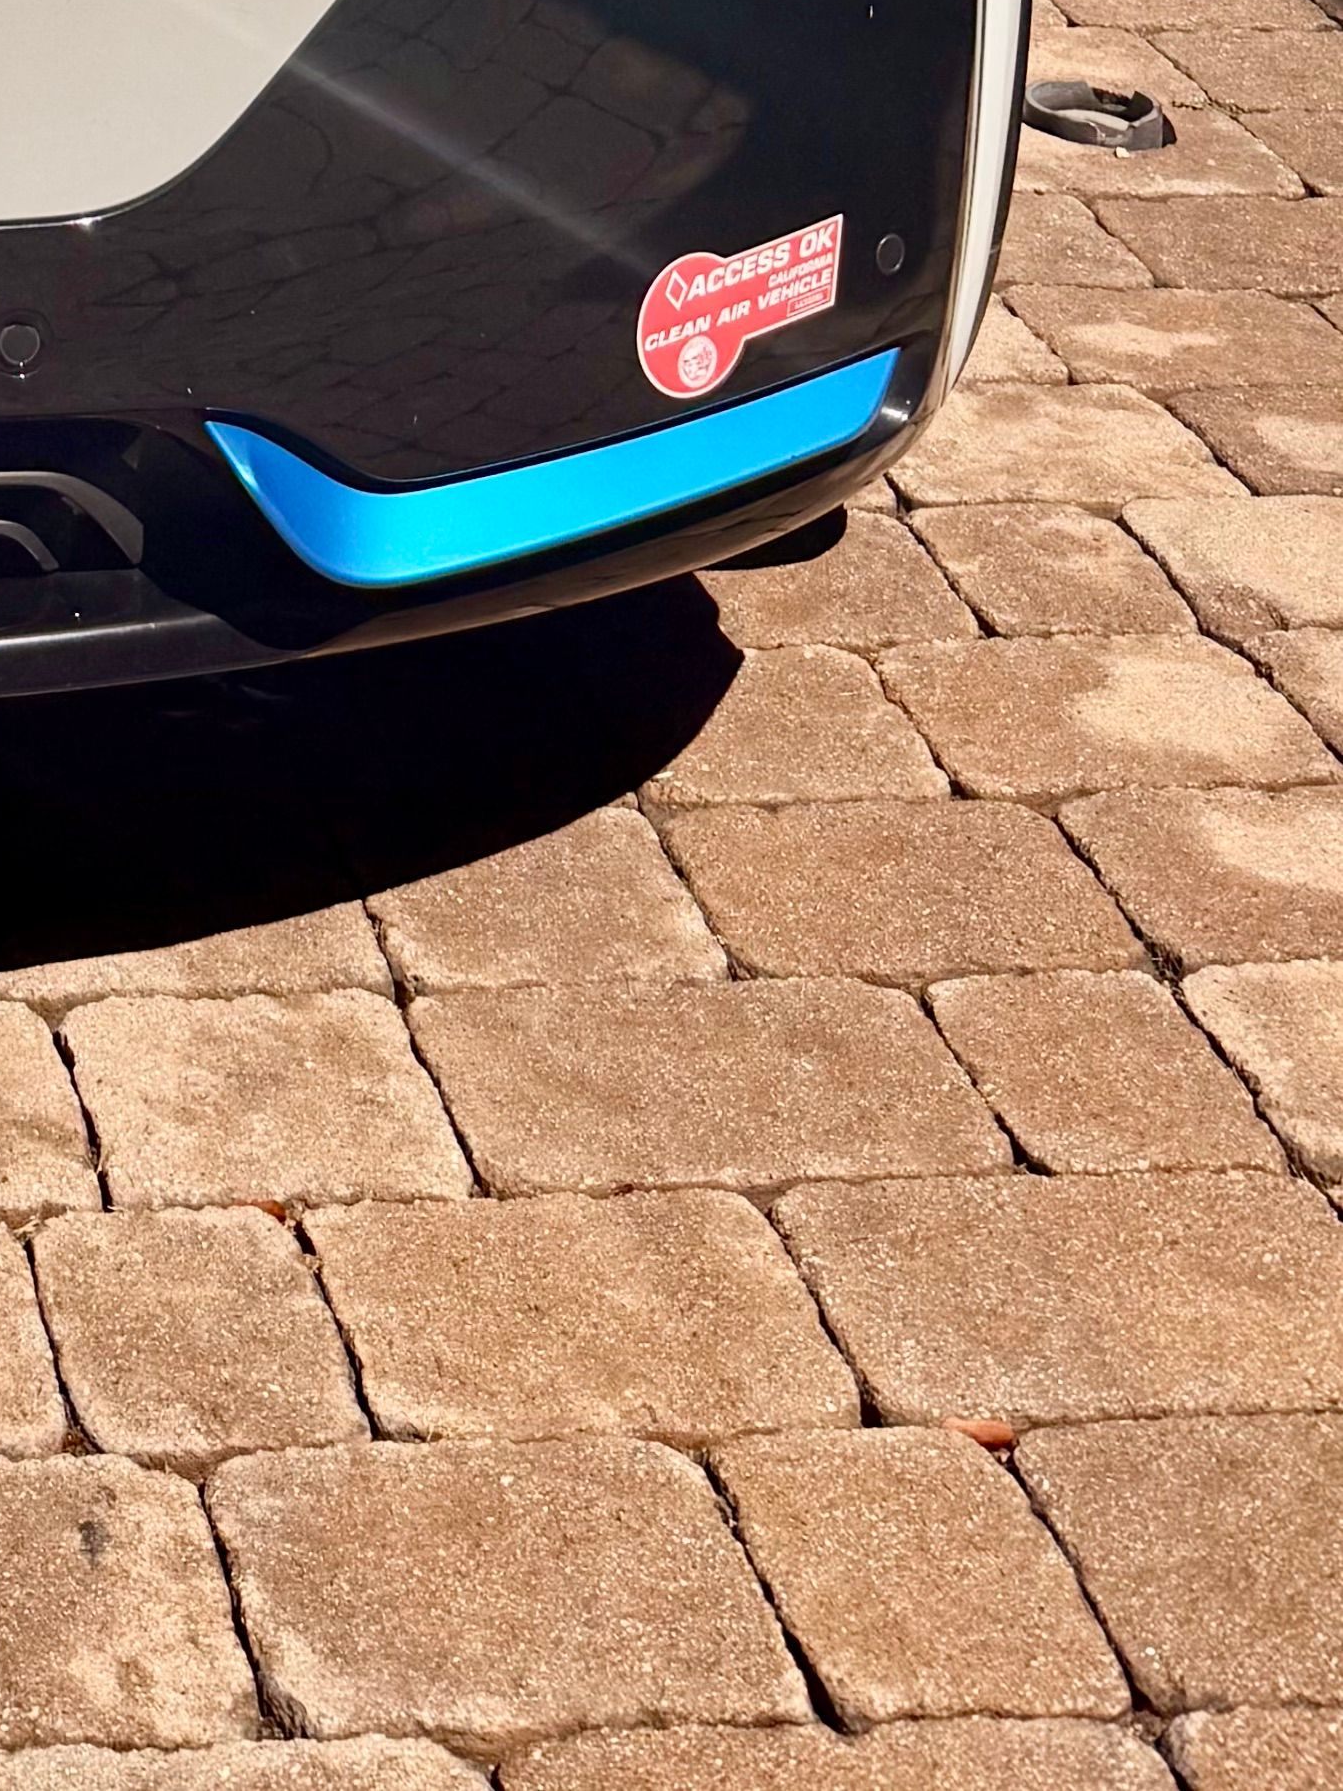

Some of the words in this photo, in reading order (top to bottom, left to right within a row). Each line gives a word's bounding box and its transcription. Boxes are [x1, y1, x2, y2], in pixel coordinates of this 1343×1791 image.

[685, 243, 791, 301] ACCESS
[800, 224, 835, 257] OK
[768, 252, 833, 287] CALIFORNIA
[644, 313, 712, 351] CLEAN
[716, 300, 751, 327] AIR
[758, 267, 833, 310] VEHICLE
